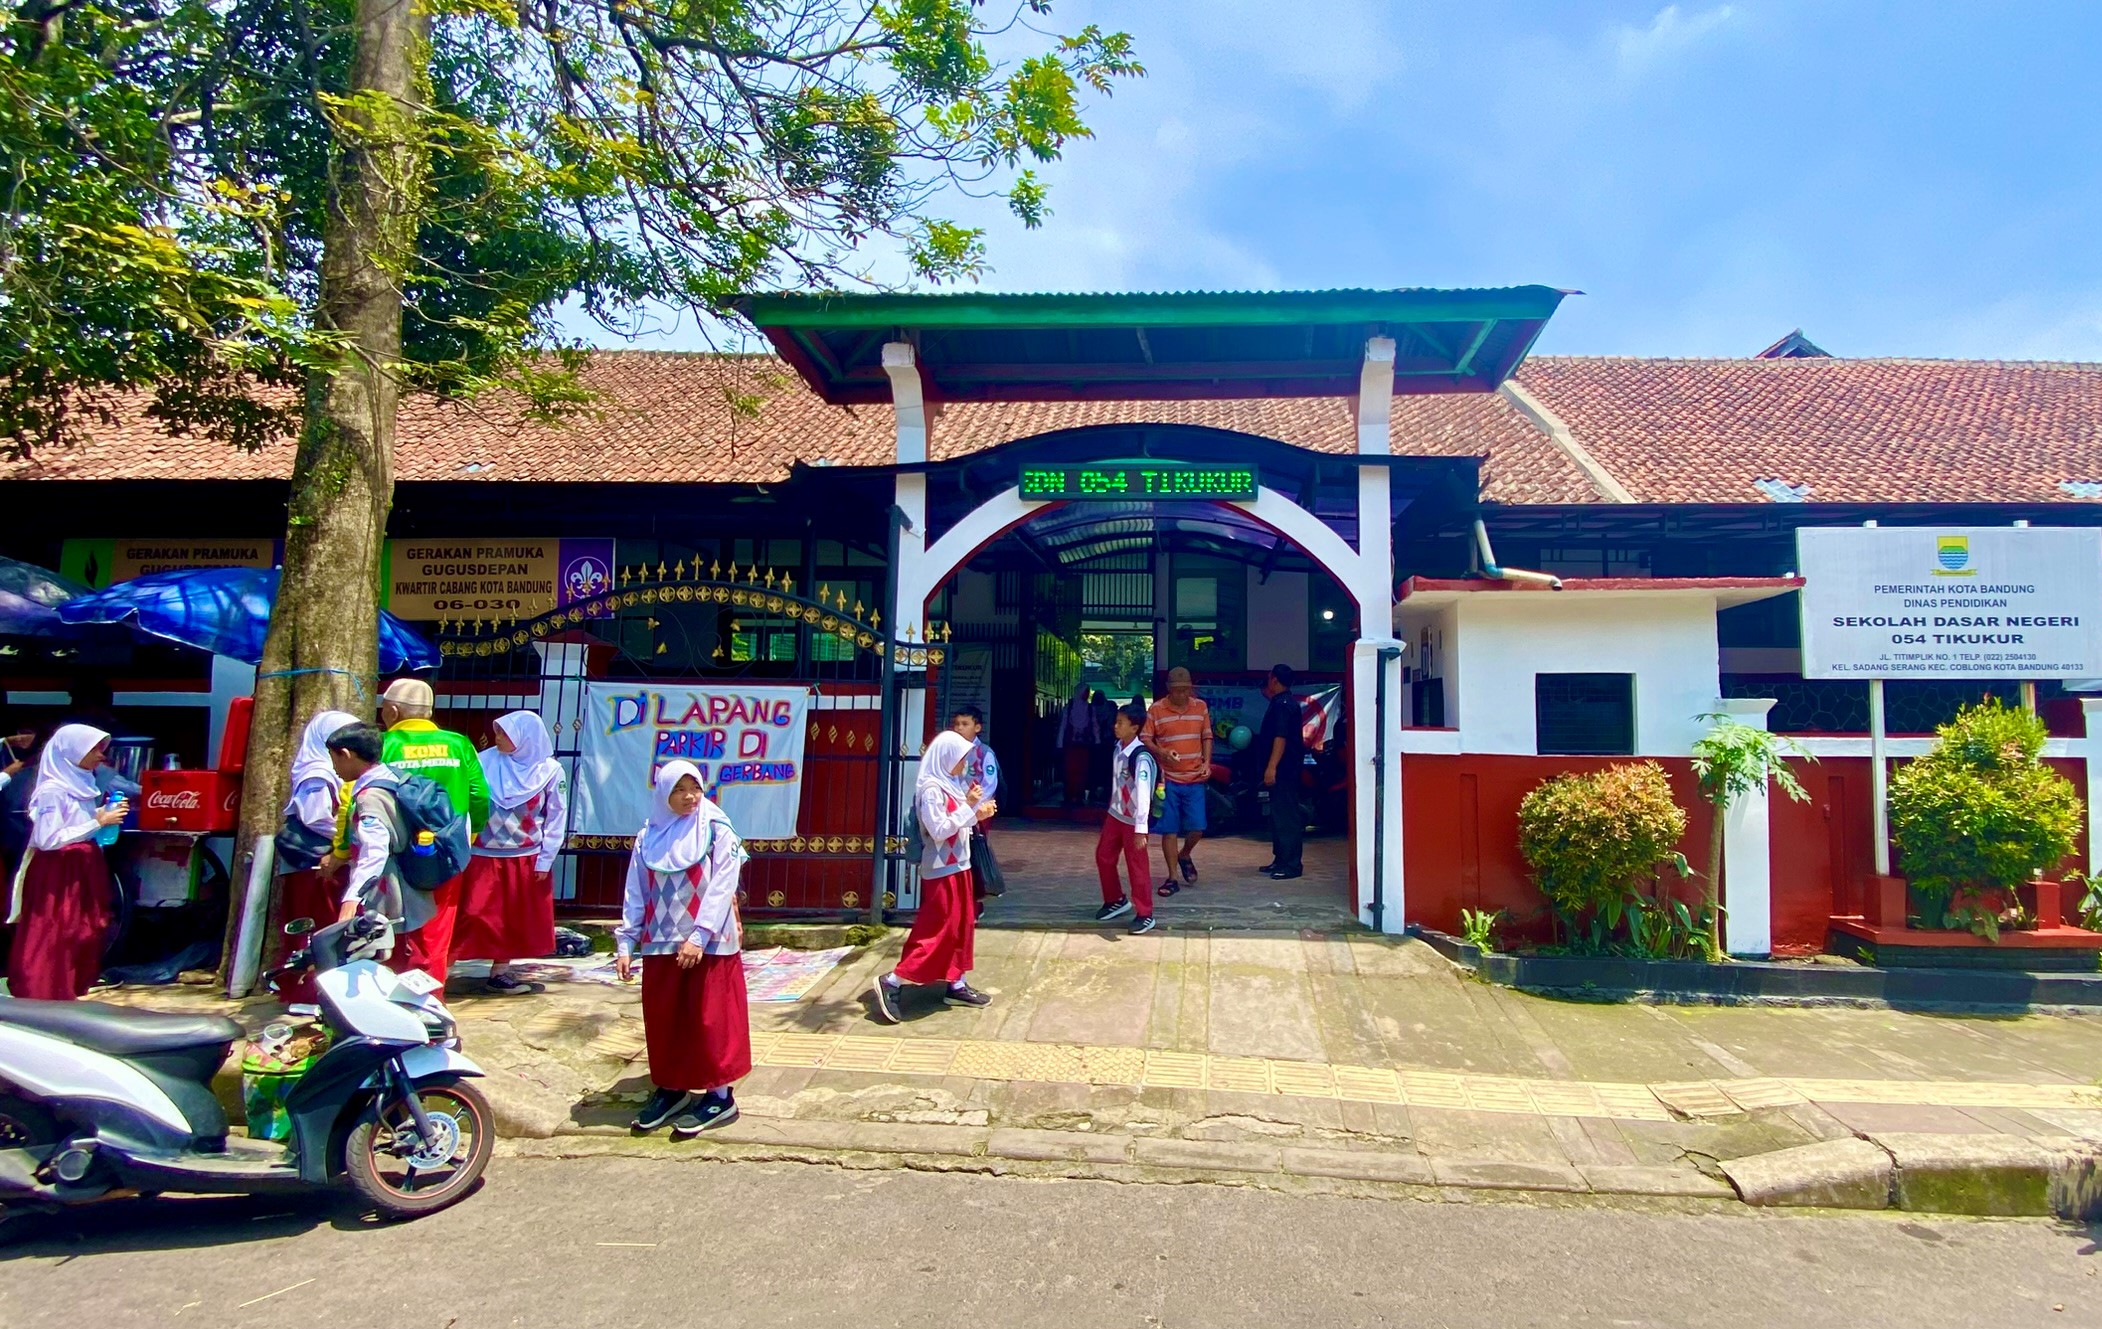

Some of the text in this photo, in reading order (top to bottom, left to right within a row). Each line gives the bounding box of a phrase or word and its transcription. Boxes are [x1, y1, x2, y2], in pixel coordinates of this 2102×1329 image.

[1080, 470, 1129, 493] 054
[1140, 470, 1254, 493] TIKUKUR
[126, 547, 259, 560] GERAKAN PRAMUKA
[406, 546, 545, 560] GERAKAN PRAMUKA
[422, 563, 528, 576] GUGUSDEPAN
[395, 580, 552, 595] KWARTIR CABANG KOTA BANDUNG
[1874, 584, 2035, 594] PEMERINTAH KOTA BANDUNG
[433, 599, 521, 610] 06-030
[1904, 598, 2007, 608] DINAS PENDIDIKAN
[1833, 616, 2079, 627] SEKOLAH DASAR NEGERI
[1892, 634, 2024, 644] 054 TIKUKUR
[1879, 653, 1891, 661] JL.
[1894, 653, 1933, 661] TITIMPLIK
[1935, 653, 1950, 661] NO.
[1983, 653, 2002, 662] (022)
[1832, 663, 1850, 671] KEL.
[1853, 663, 1889, 671] SADANG
[1891, 663, 1926, 671] SERANG
[1928, 663, 1948, 671] KEC.
[1950, 663, 1991, 671] COBLONG
[1993, 663, 2016, 671] KOTA
[2018, 663, 2059, 671] BANDUNG
[611, 691, 647, 731] DI
[655, 729, 767, 758] PARKIR DI
[403, 744, 449, 759] KONI
[719, 763, 796, 783] GERBANG
[147, 790, 202, 809] Coca-Cola
